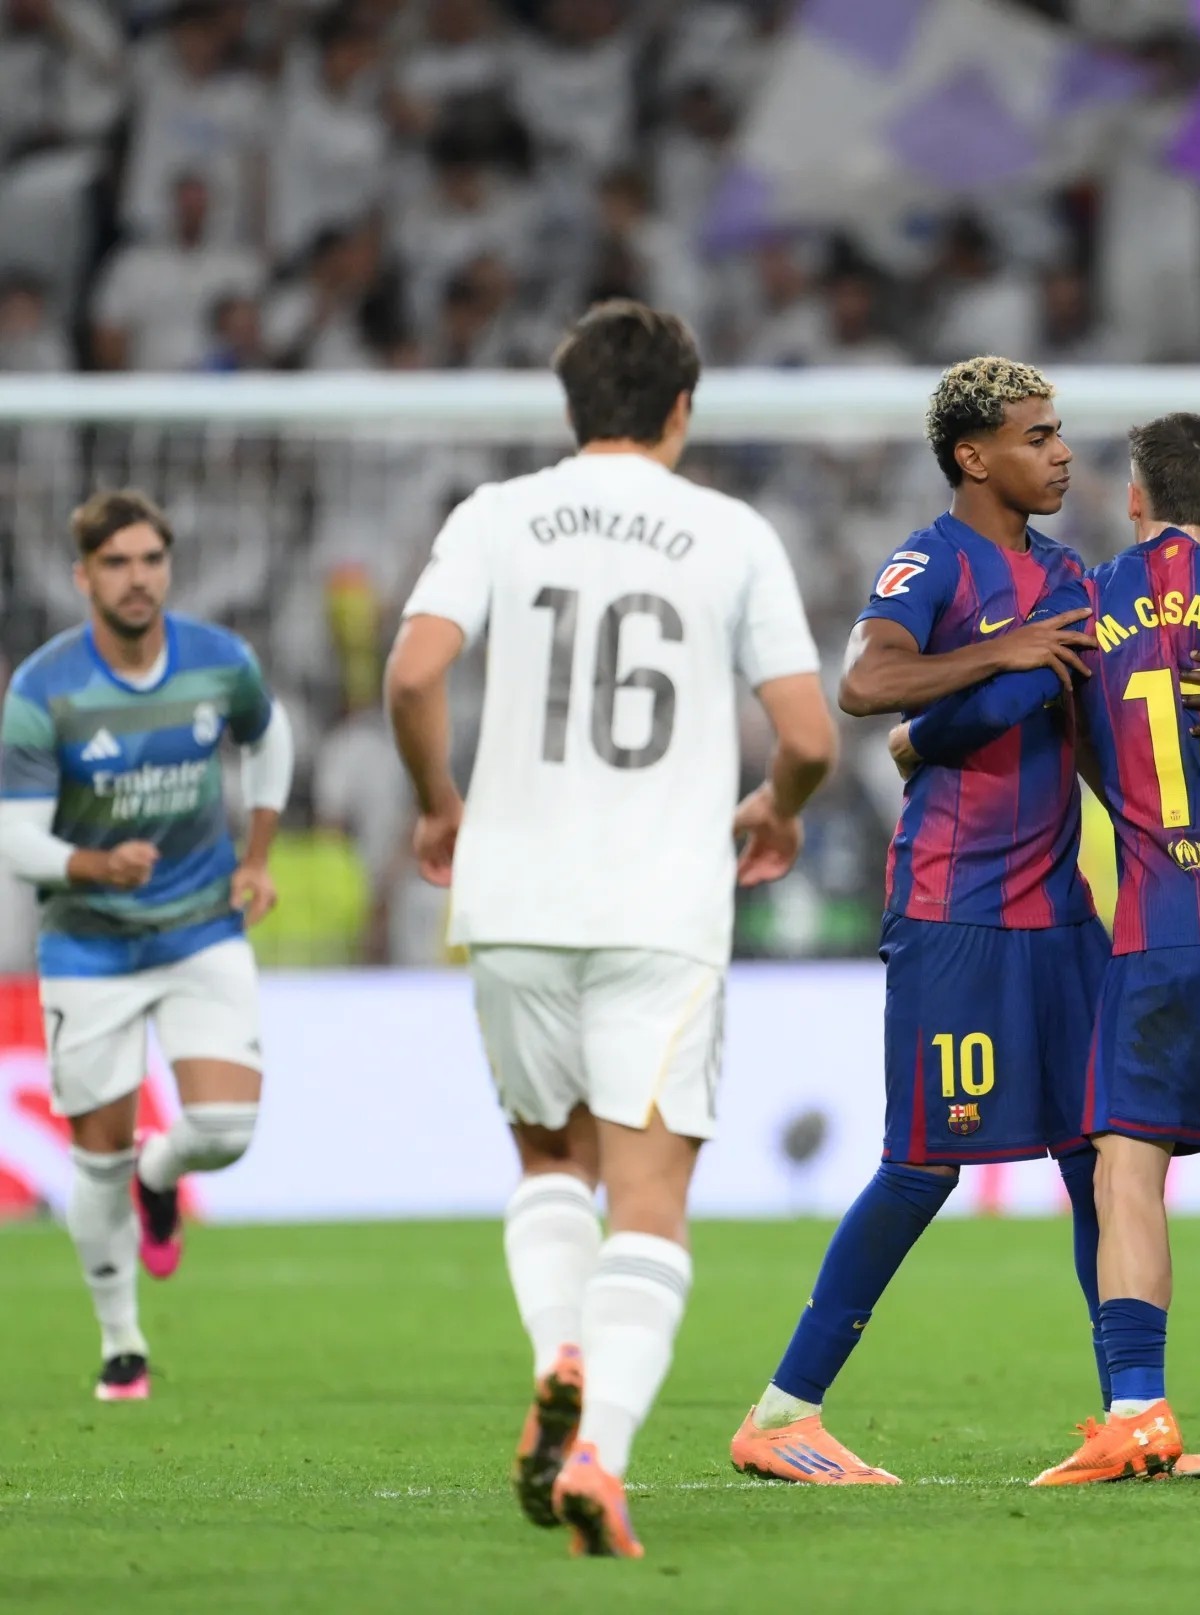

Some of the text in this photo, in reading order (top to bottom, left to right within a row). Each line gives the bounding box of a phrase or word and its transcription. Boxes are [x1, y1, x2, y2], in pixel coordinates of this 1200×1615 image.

[530, 506, 694, 561] GONZALO
[1095, 614, 1139, 653] M.
[532, 586, 684, 770] 16
[931, 1032, 995, 1098] 10
